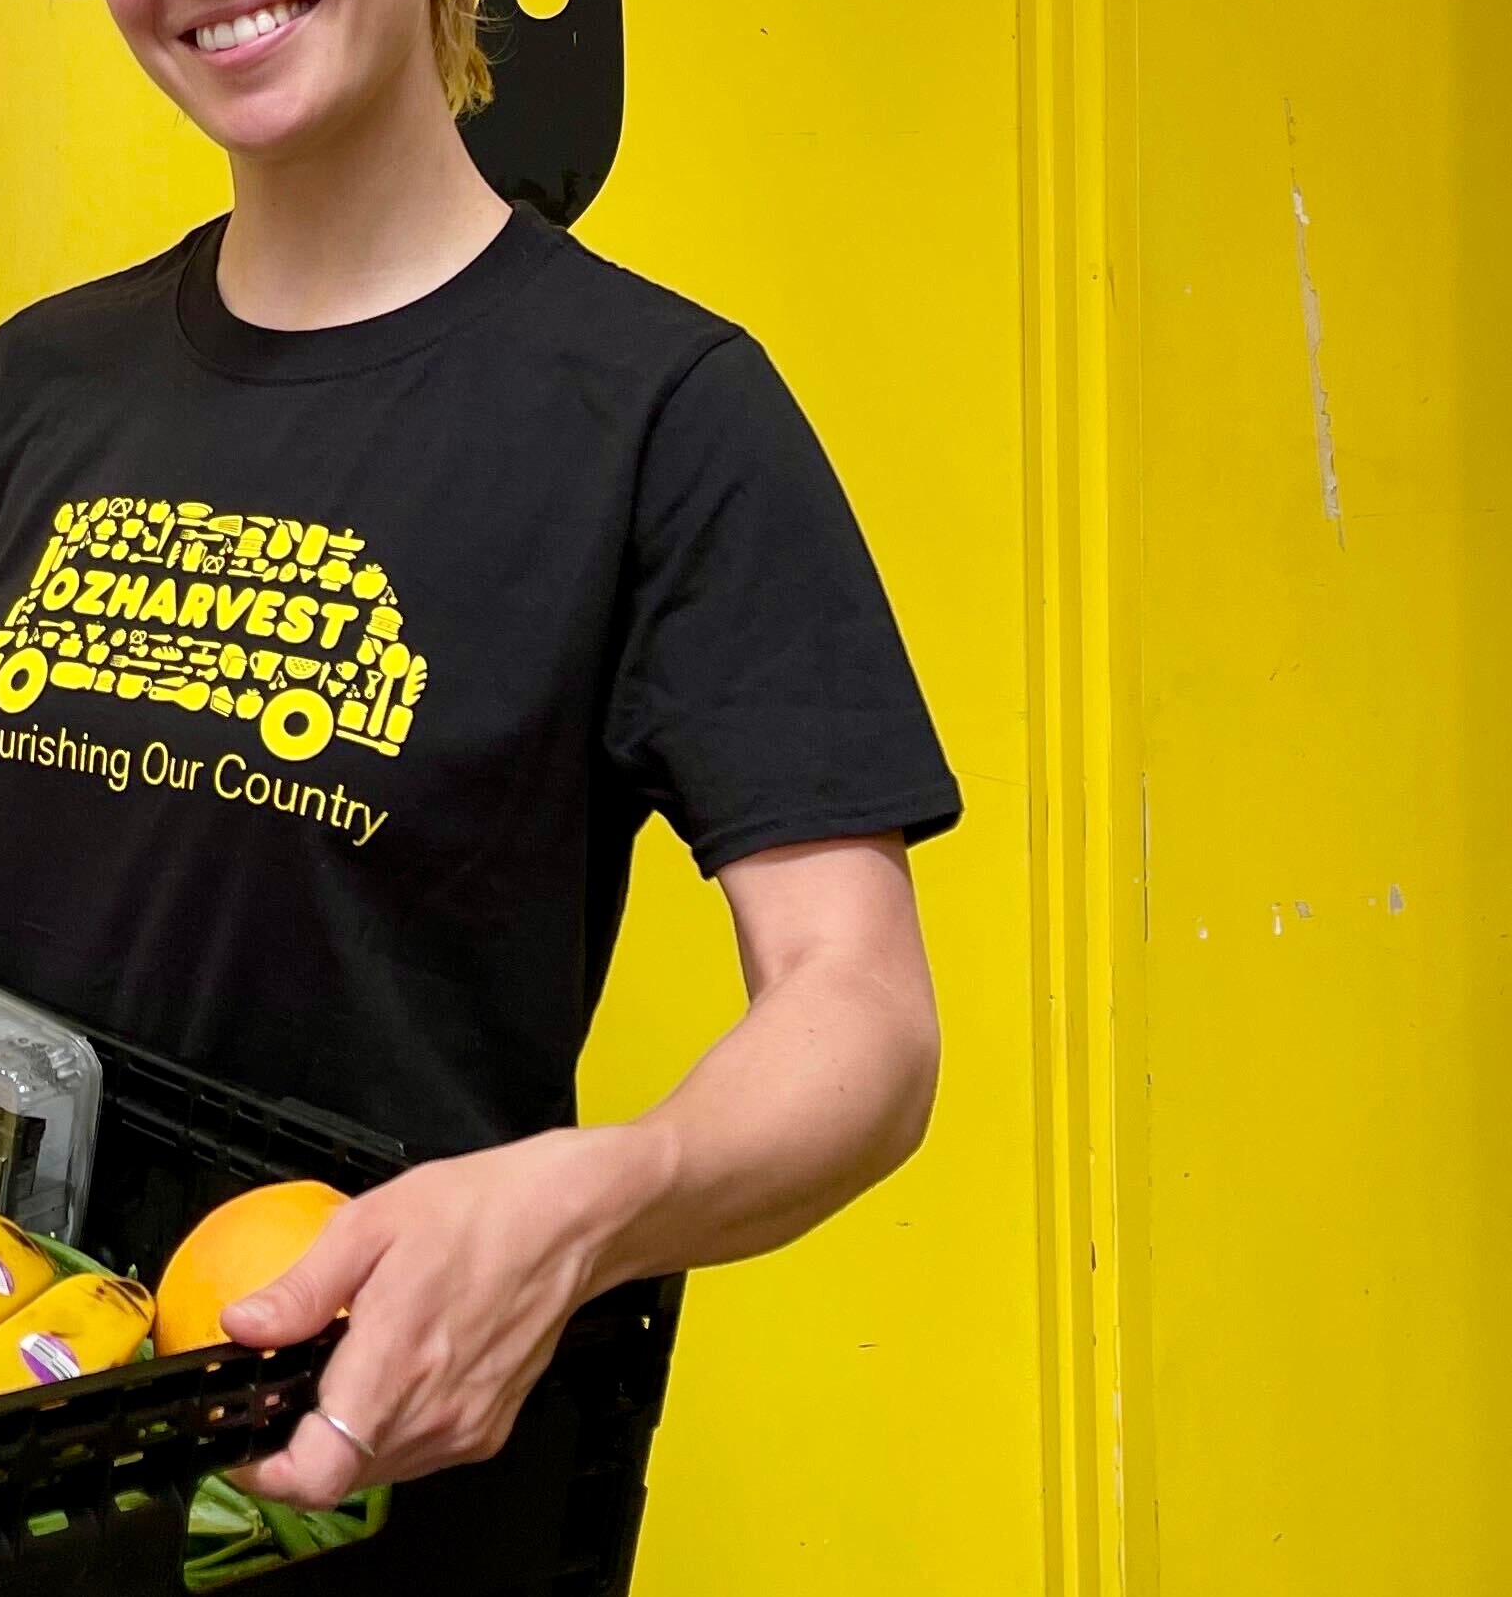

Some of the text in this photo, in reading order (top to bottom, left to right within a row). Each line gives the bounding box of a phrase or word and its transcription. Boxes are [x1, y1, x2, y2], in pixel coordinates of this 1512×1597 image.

[41, 566, 359, 650] OZHARVEST
[141, 742, 204, 790] Our
[213, 753, 389, 847] Country
